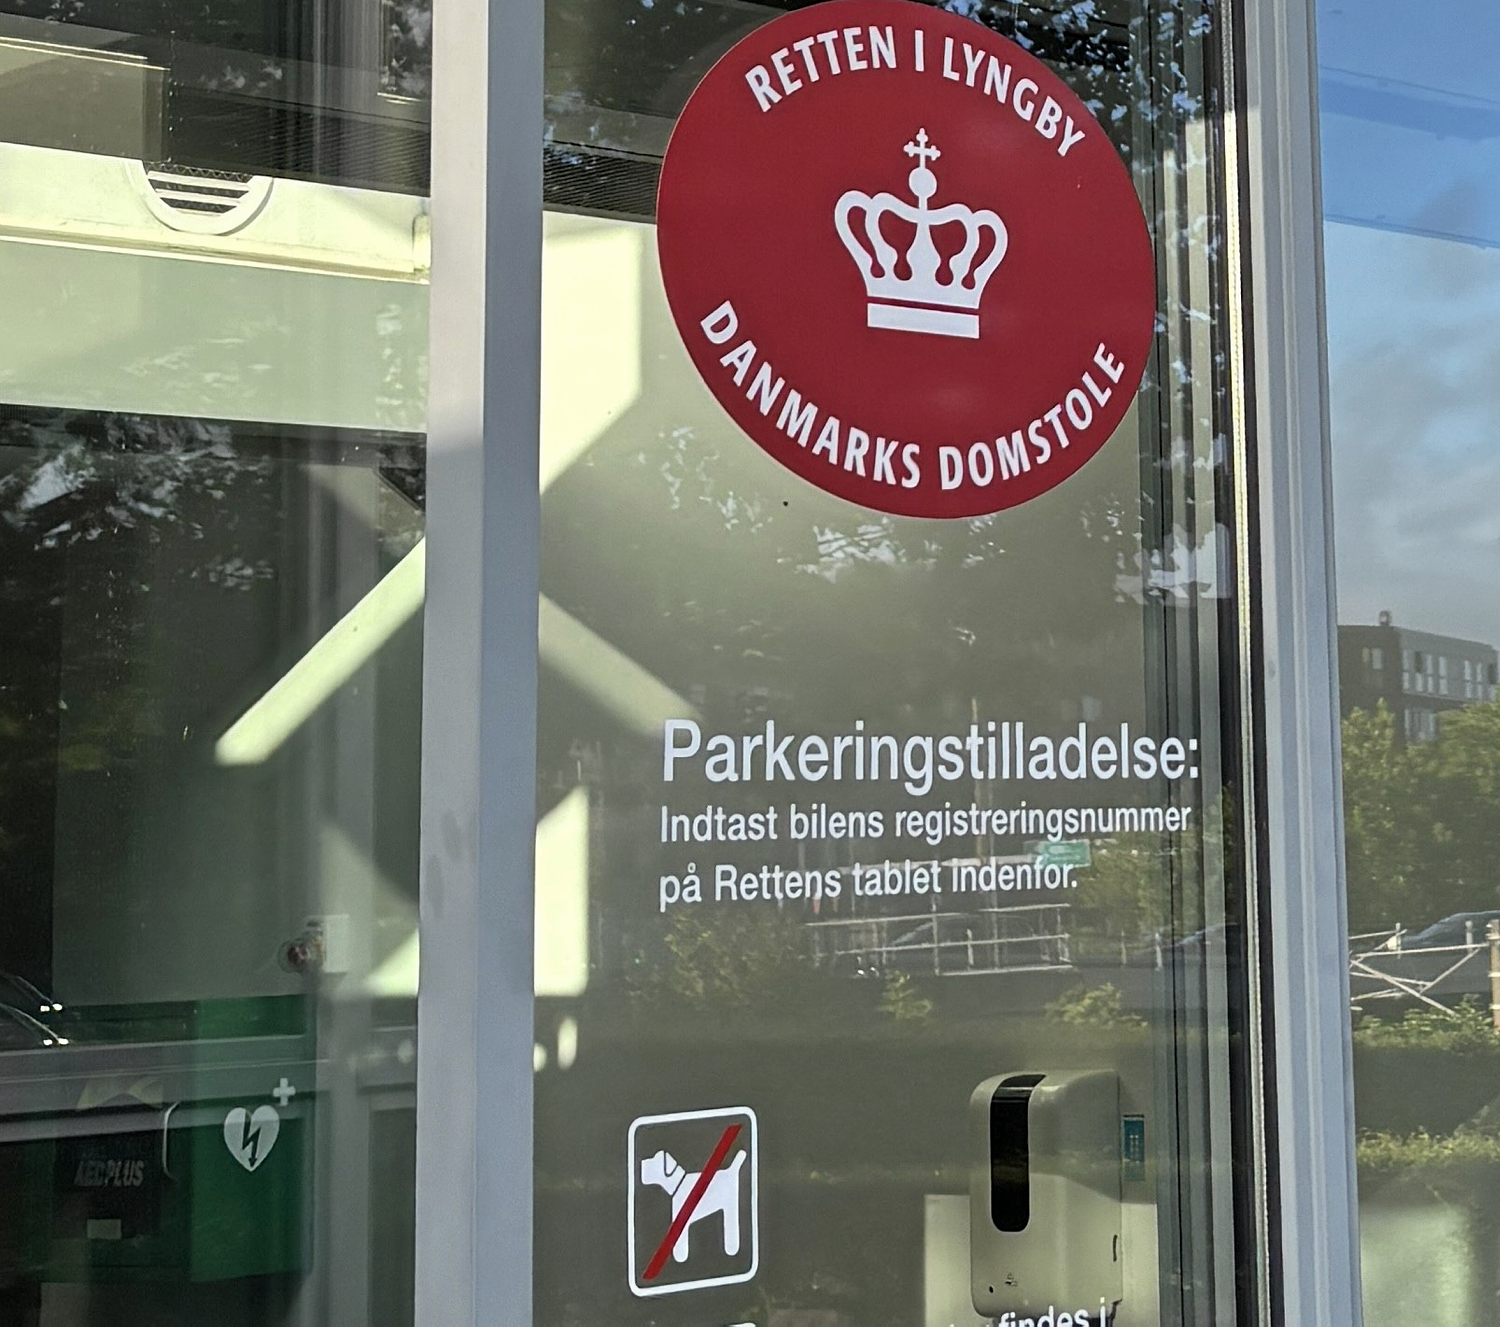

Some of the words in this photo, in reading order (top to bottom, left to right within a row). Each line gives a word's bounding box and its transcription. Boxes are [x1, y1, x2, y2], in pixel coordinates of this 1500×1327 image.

[745, 26, 897, 113] RETTEN
[914, 30, 925, 72] I
[943, 36, 1086, 157] LYNGBY
[700, 300, 921, 489] DANMARKS
[939, 342, 1126, 491] DOMSTOLE
[663, 719, 1199, 796] Parkeringstilladelse:
[661, 805, 778, 842] Indtast
[790, 803, 885, 840] bilens
[895, 801, 1192, 846] registreringsnummer
[659, 862, 701, 913] på
[714, 862, 842, 901] Rettens
[852, 858, 942, 896] tablet
[951, 858, 1079, 893] indenfor.
